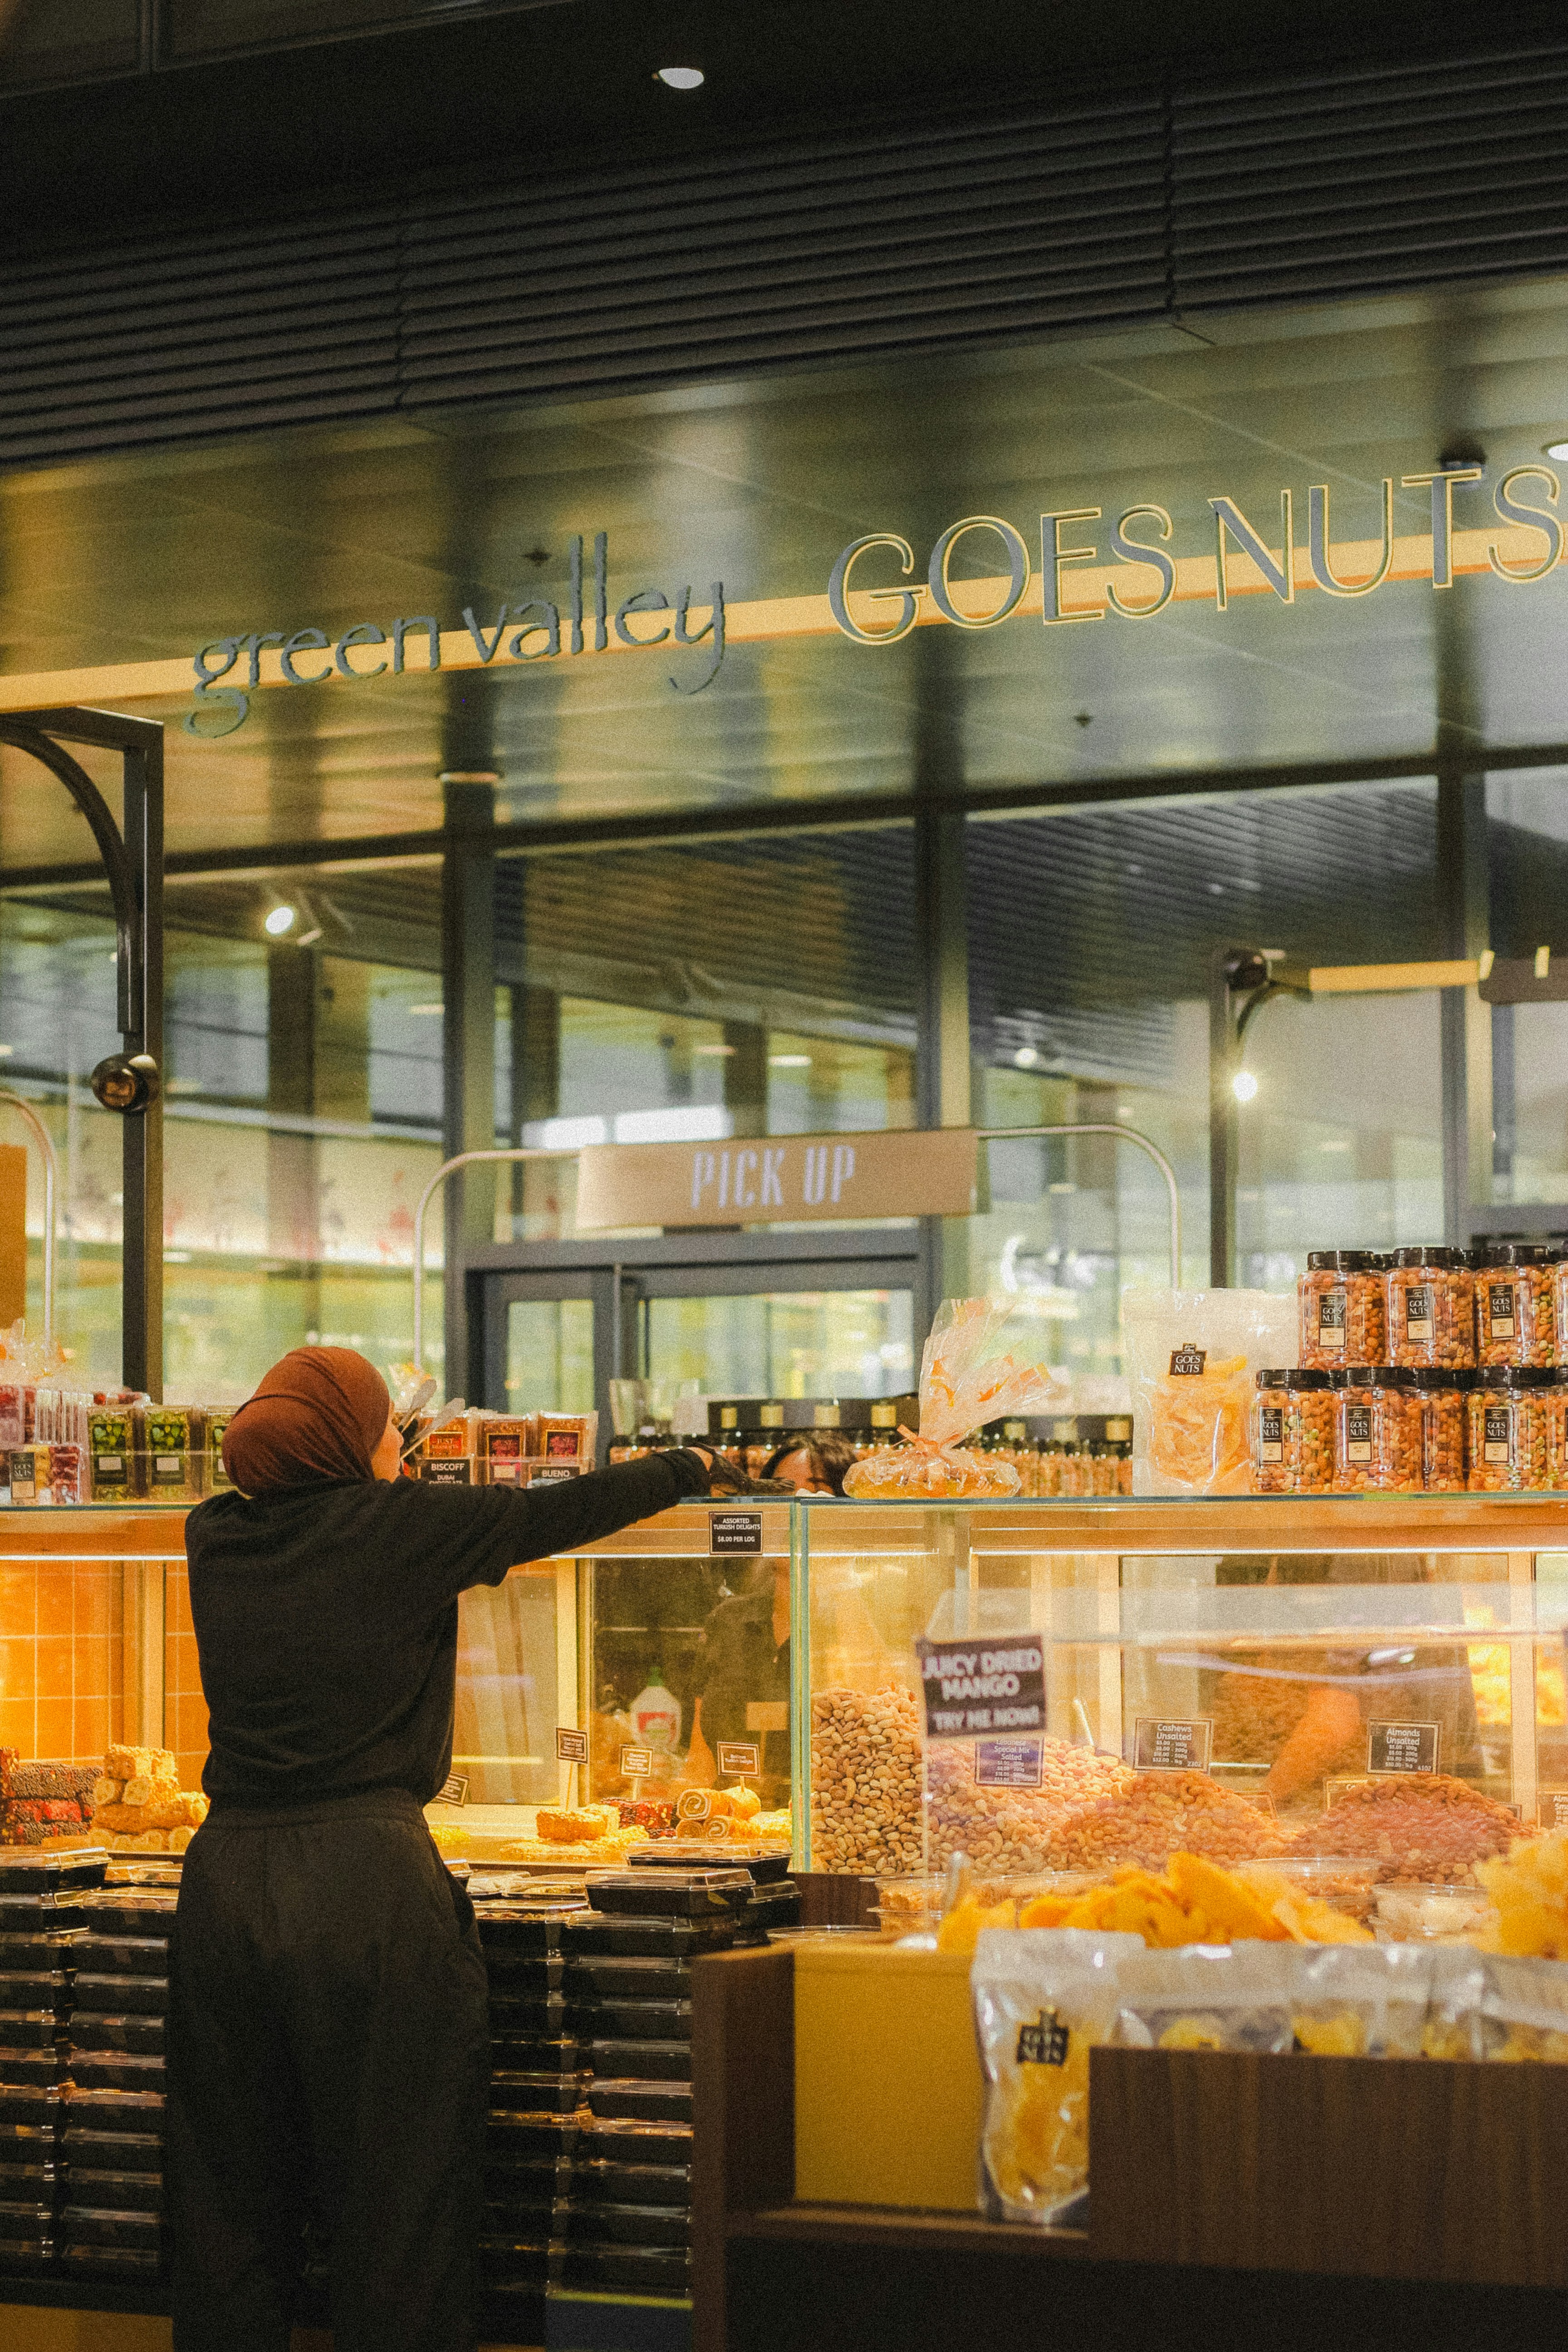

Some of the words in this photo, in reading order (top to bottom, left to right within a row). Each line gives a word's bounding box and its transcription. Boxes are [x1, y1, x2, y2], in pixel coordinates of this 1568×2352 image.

[827, 504, 1177, 646] GOES
[1207, 463, 1567, 611] NUTS
[183, 615, 443, 740] green
[461, 531, 727, 696] valley
[690, 1147, 786, 1209] PICK
[803, 1145, 856, 1205] UP
[1176, 1355, 1200, 1363] GOES
[1174, 1364, 1200, 1373] NUTS
[431, 1463, 465, 1471] BISCOFF
[923, 1654, 977, 1679] JUICY
[980, 1648, 1041, 1675] DRIED
[941, 1673, 1020, 1702] MANGO
[932, 1710, 964, 1731] TRY
[1157, 1724, 1192, 1732] Cashews
[1387, 1728, 1420, 1737] Almonds
[1156, 1732, 1192, 1740] Unsalted
[1386, 1737, 1420, 1745] Unsalted
[994, 1745, 1017, 1754] Special
